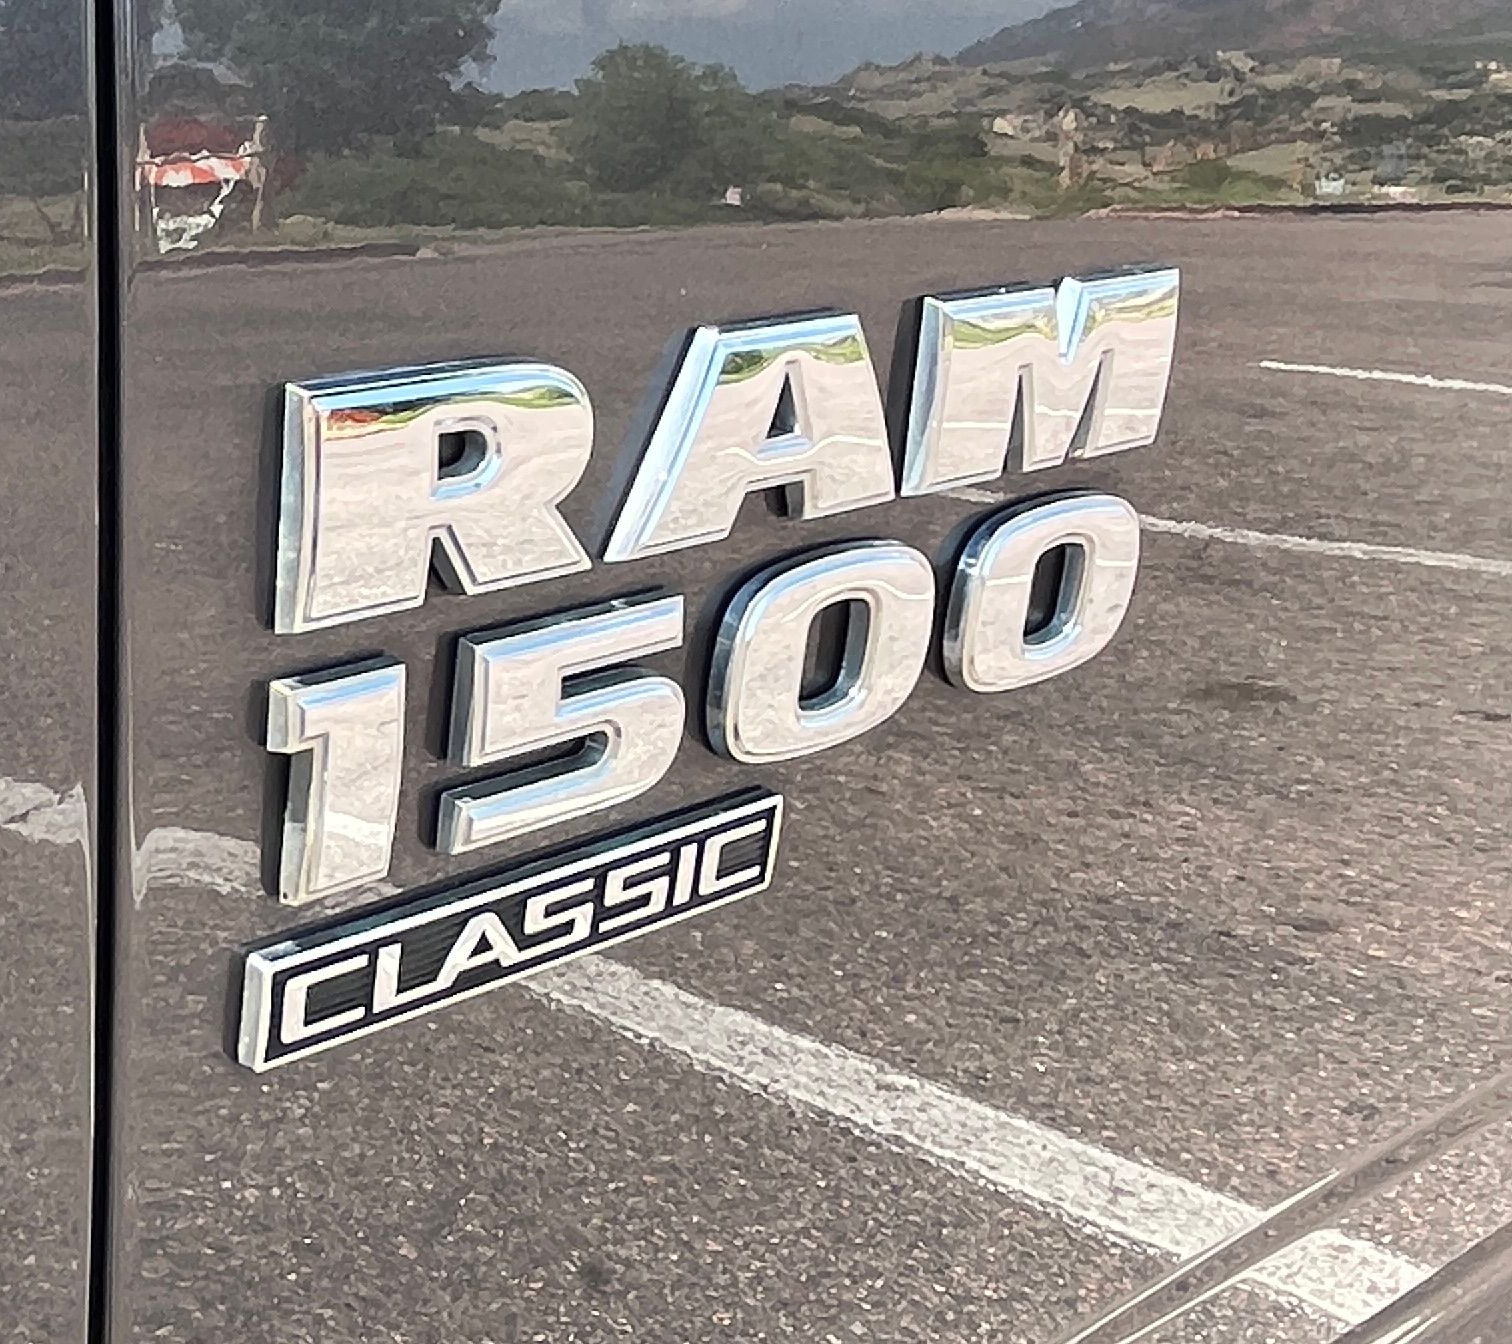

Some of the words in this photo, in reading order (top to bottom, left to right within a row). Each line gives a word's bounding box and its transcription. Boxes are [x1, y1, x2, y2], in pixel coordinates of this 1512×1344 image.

[274, 267, 1180, 635] RAM
[267, 488, 1141, 906] 1500
[280, 818, 769, 1045] CLASSIC
